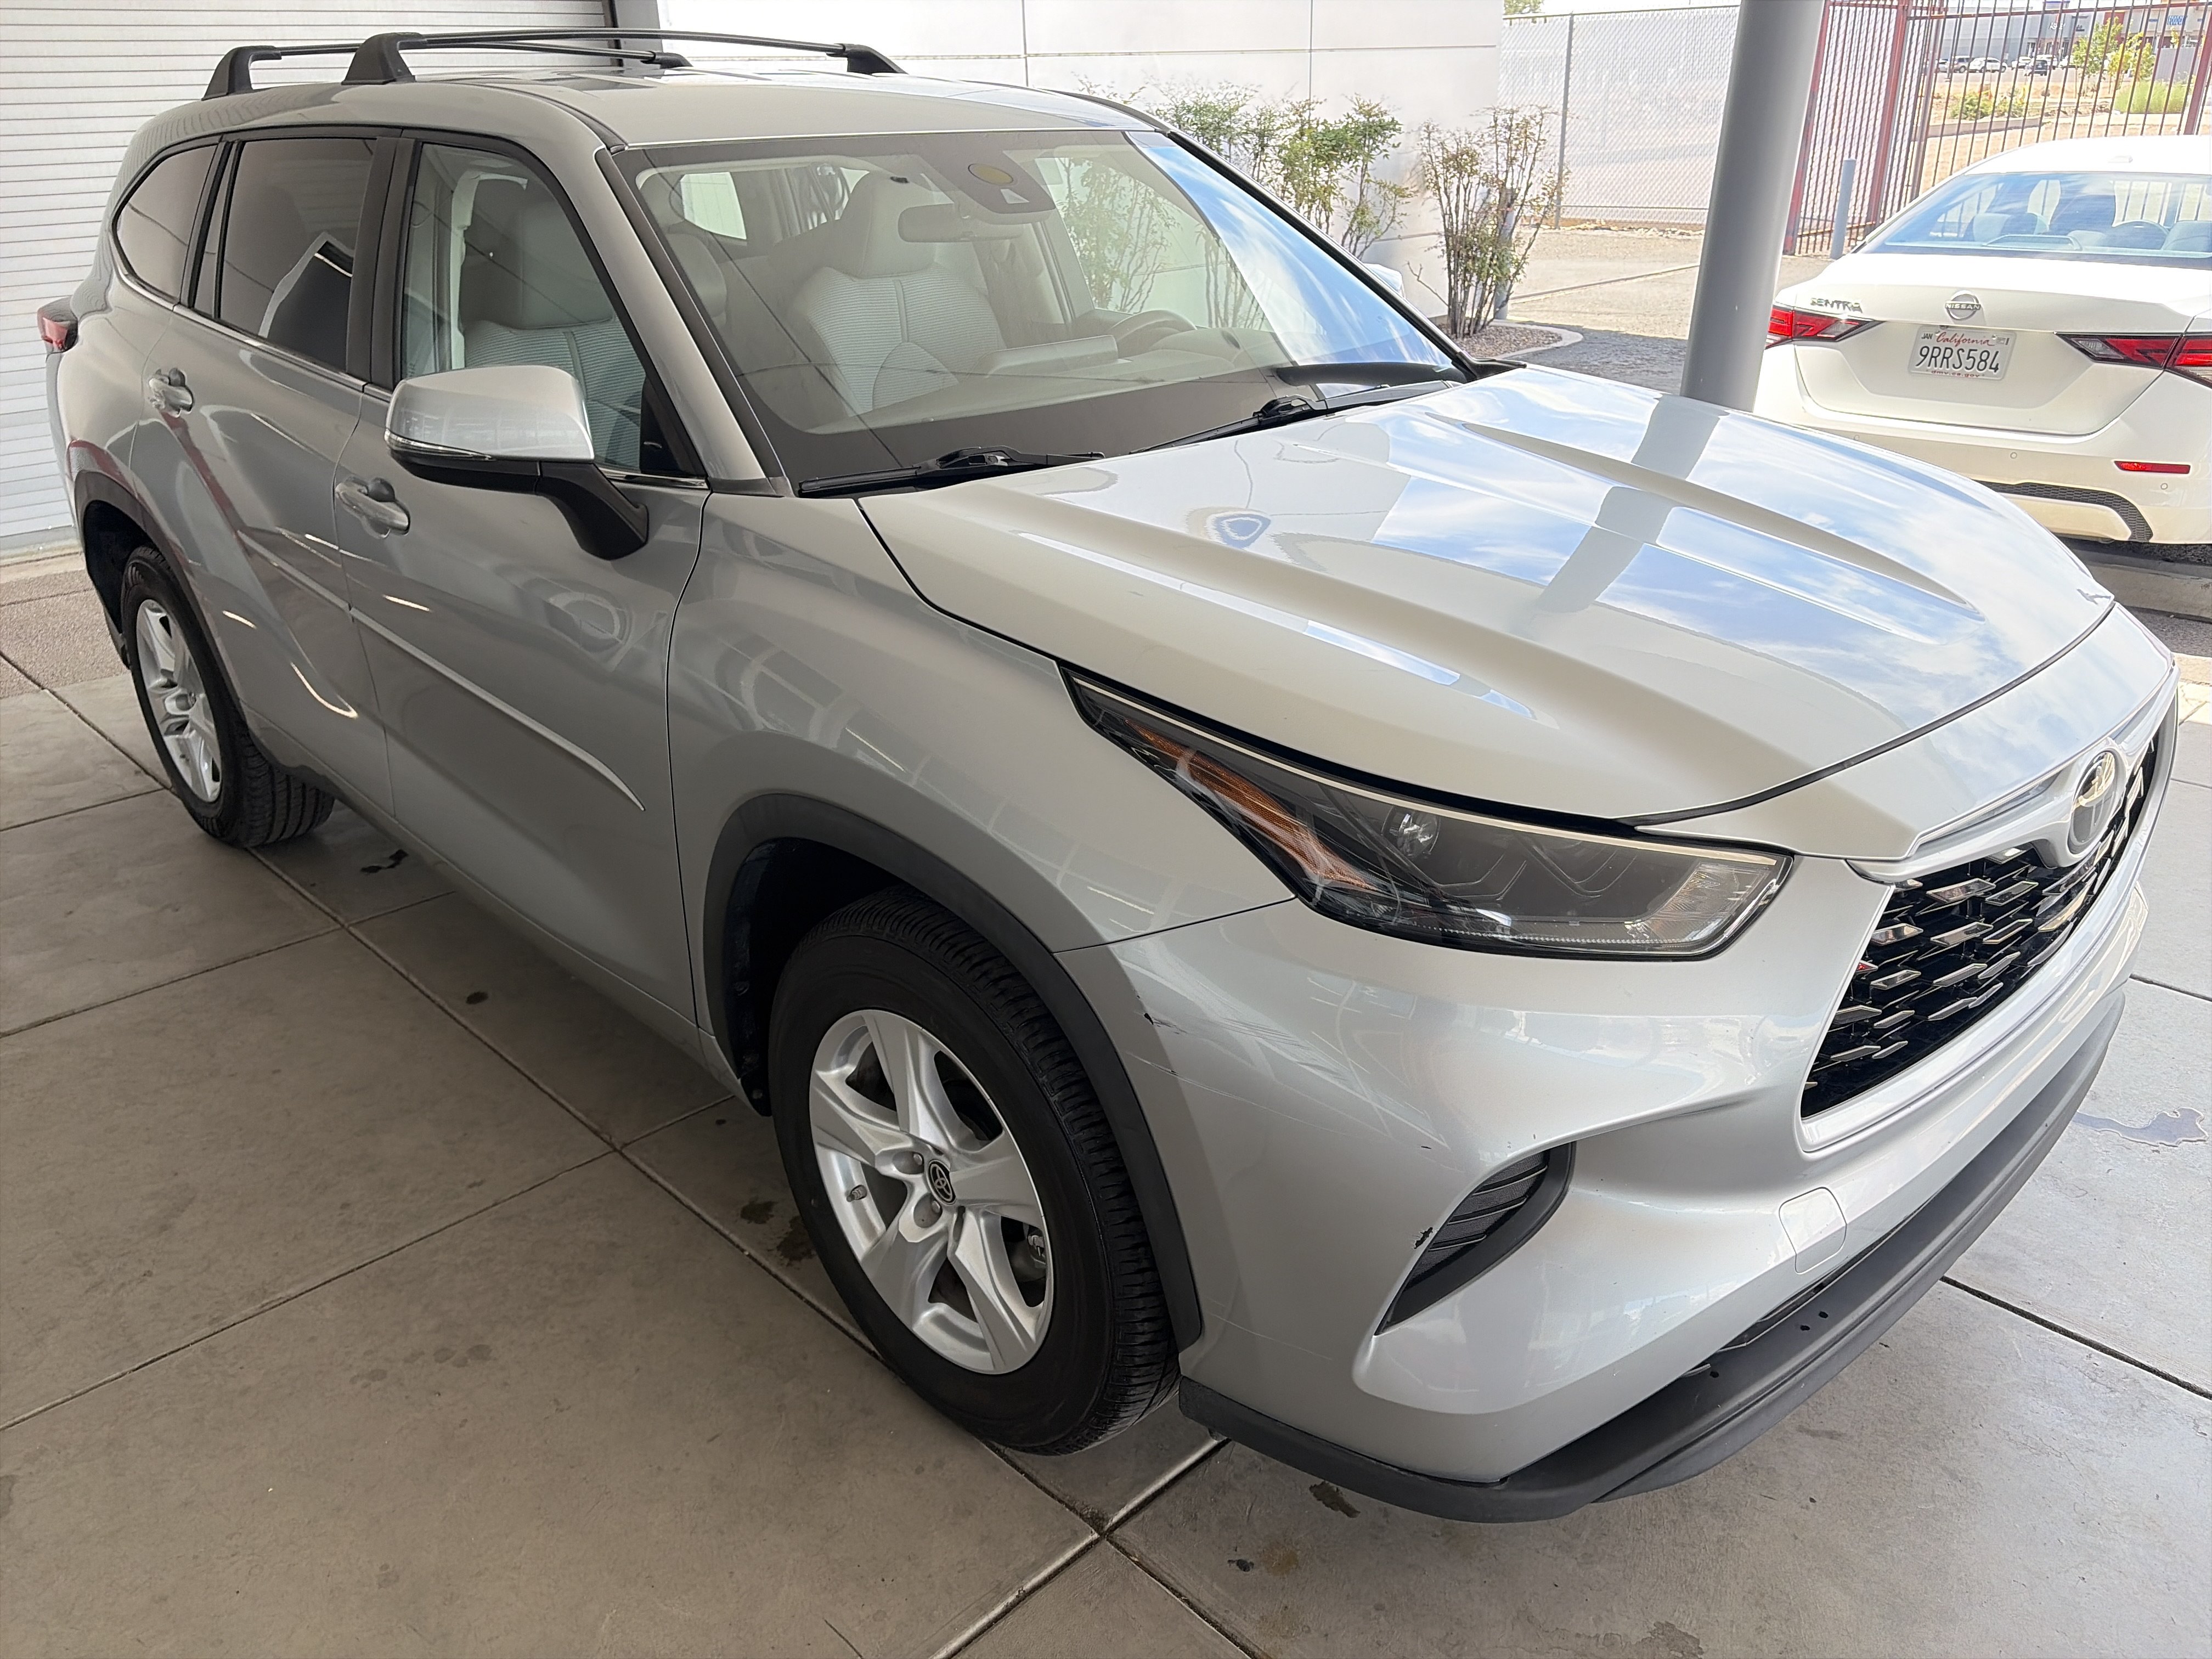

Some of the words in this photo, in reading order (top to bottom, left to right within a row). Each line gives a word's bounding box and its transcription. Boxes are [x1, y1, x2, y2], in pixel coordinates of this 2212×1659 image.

[1810, 298, 1863, 314] SENTRA
[1936, 331, 1995, 347] California
[1915, 346, 1999, 373] 9RRS584
